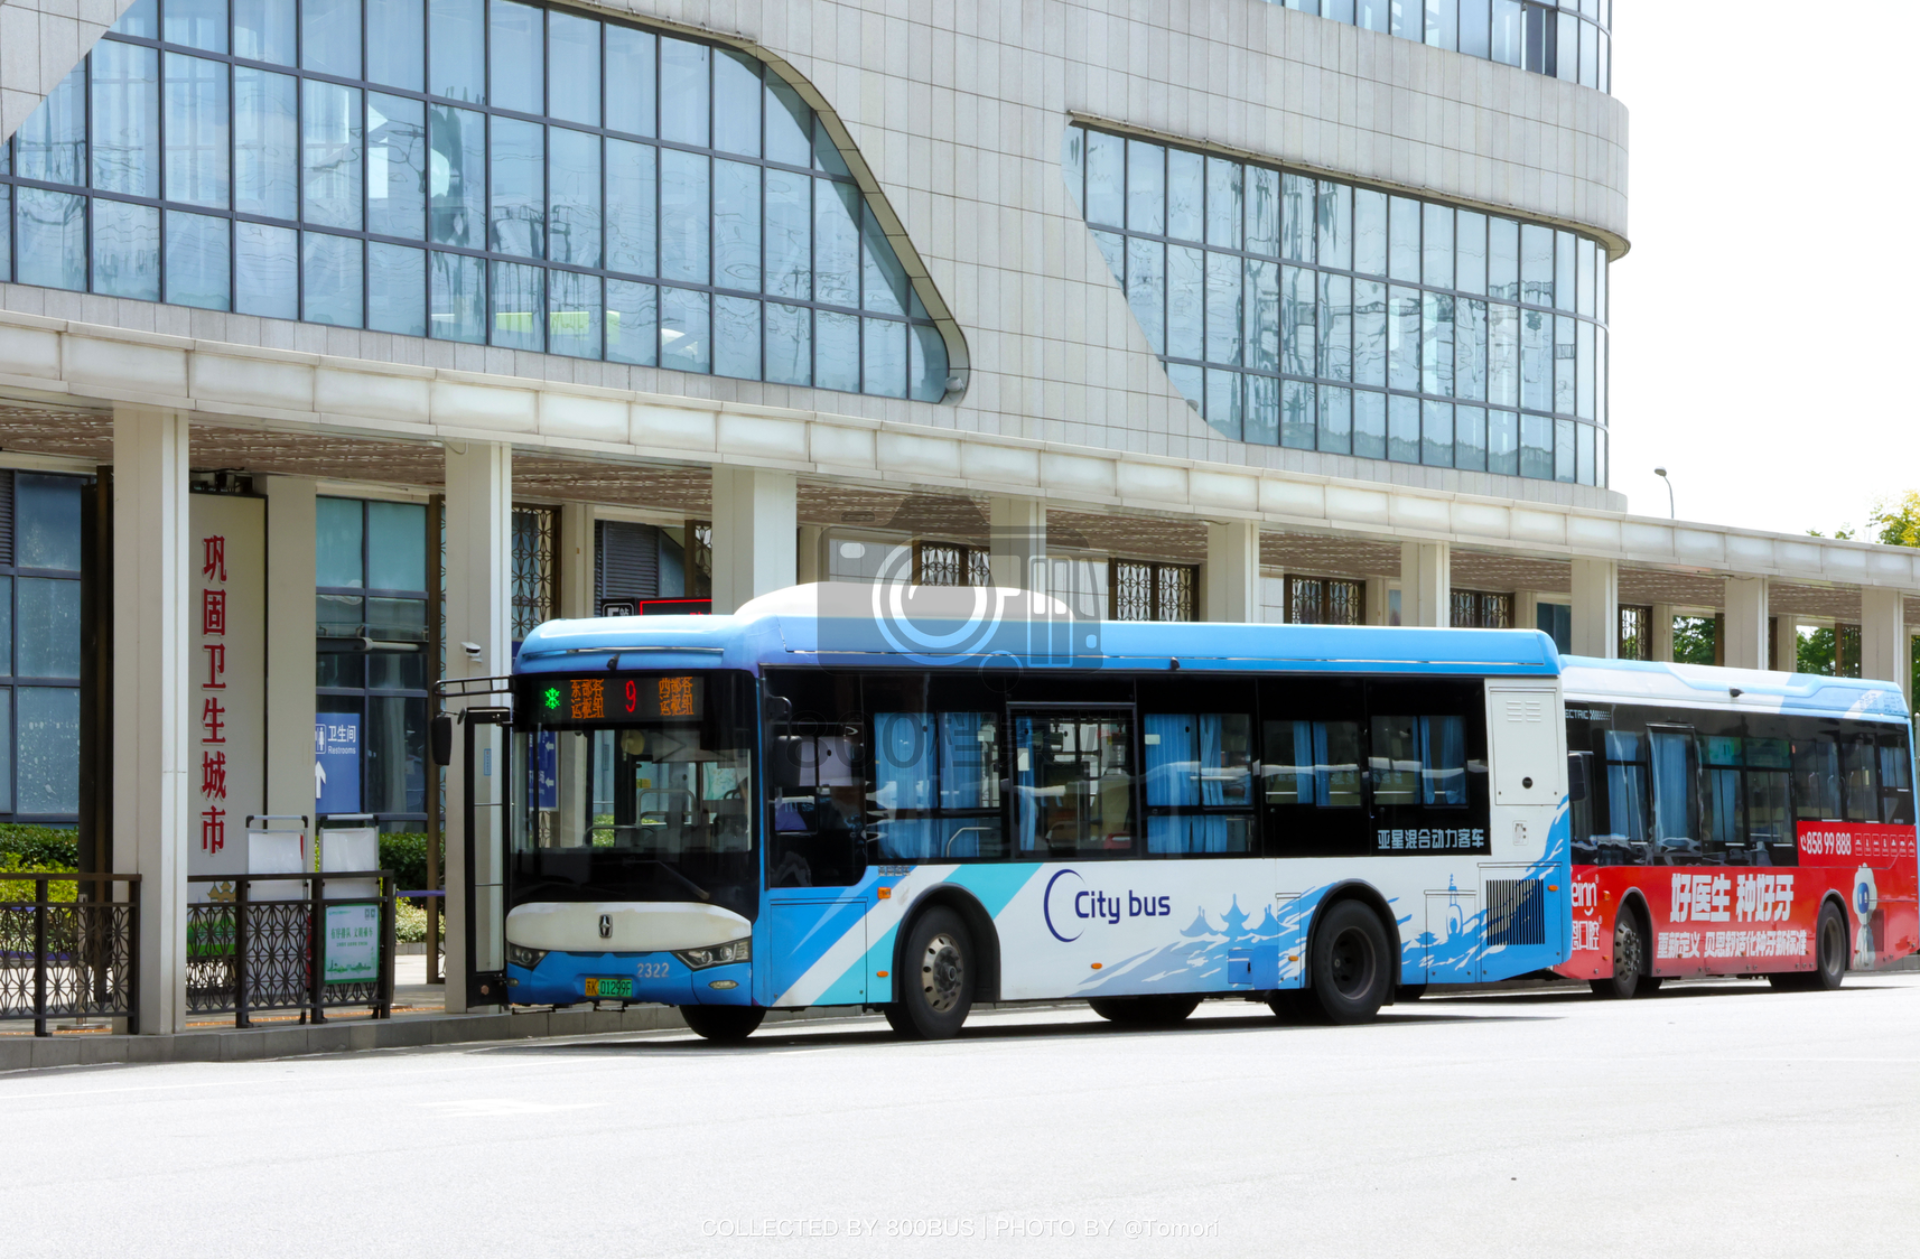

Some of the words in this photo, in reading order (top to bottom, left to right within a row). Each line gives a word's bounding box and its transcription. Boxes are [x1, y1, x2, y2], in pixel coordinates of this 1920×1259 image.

[201, 534, 227, 854] 巩固卫生城市
[625, 680, 636, 713] 9
[328, 724, 356, 743] 卫生间
[328, 746, 356, 755] Restrooms
[1377, 828, 1485, 850] 亚星混合动力客车
[1806, 831, 1823, 855] 858
[1824, 831, 1835, 855] 99
[1836, 832, 1852, 855] 888
[1074, 890, 1120, 925] City
[1129, 889, 1171, 917] bus
[1670, 873, 1731, 923] 好医生
[1736, 873, 1794, 923] 种好牙
[1656, 931, 1700, 959] 重新定义
[637, 962, 669, 979] 2322
